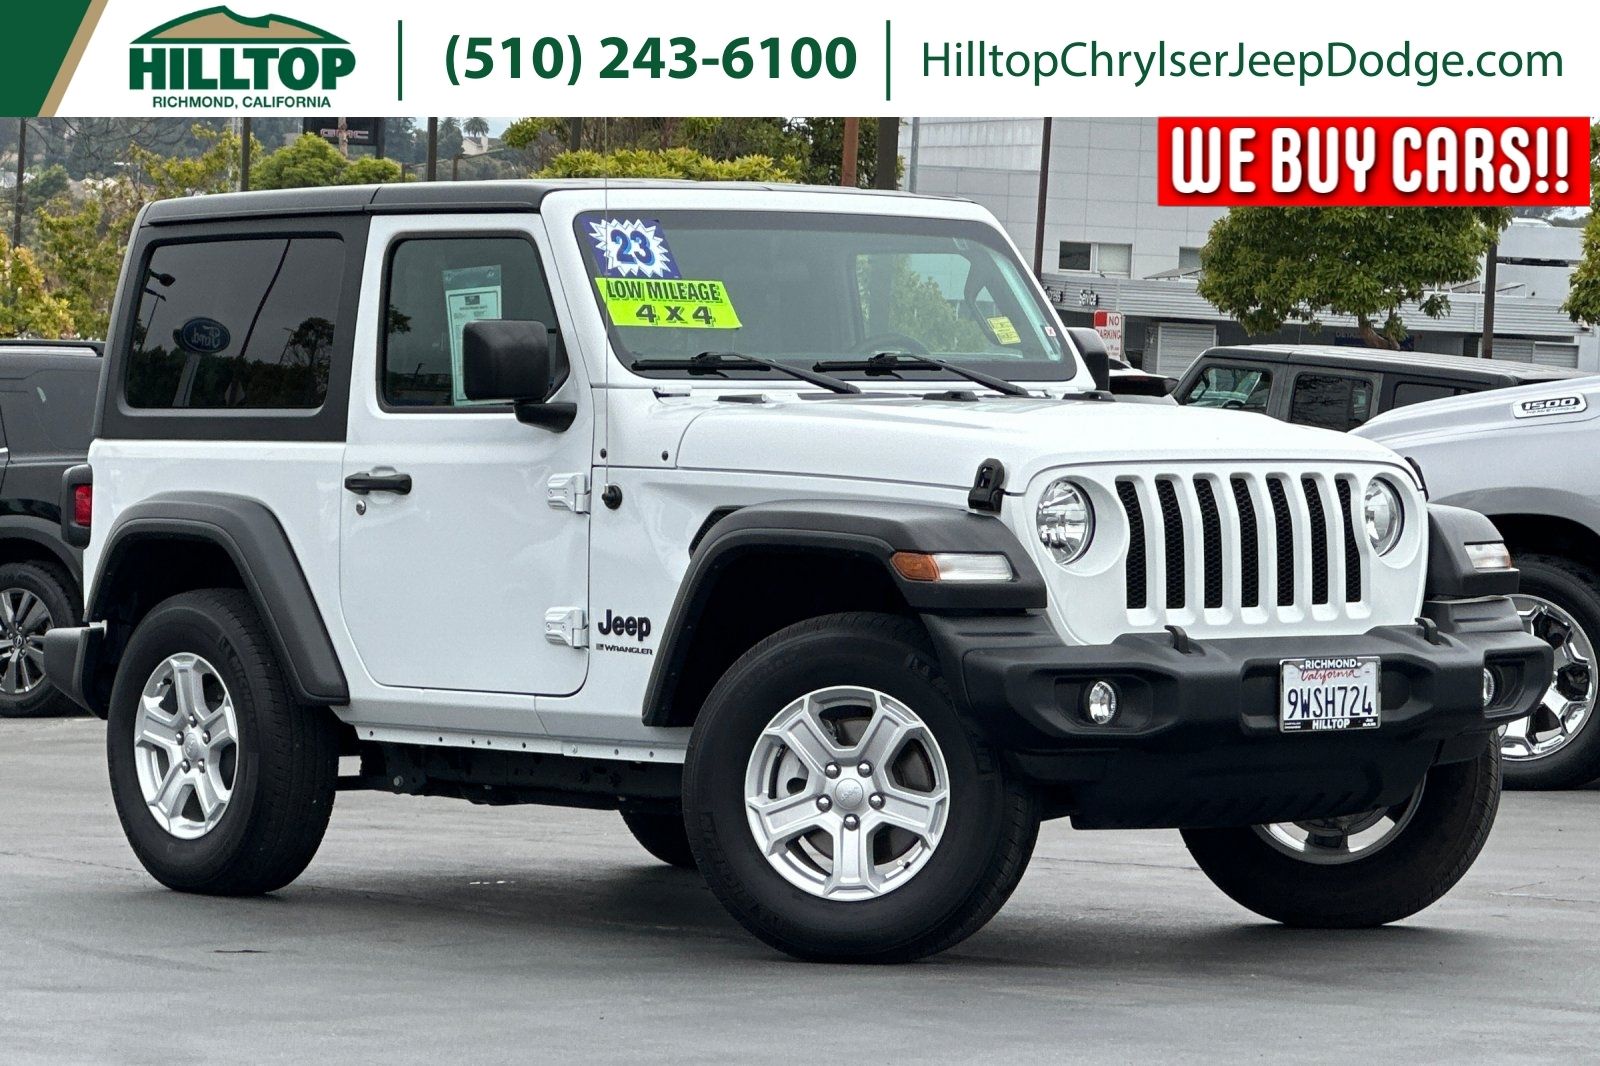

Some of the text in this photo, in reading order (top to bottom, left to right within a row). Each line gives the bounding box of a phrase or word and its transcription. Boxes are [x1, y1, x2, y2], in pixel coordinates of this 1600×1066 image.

[610, 229, 655, 266] 23
[606, 280, 722, 303] LOW MILEAGE
[1108, 316, 1120, 326] NO
[1524, 397, 1577, 411] 1500
[597, 609, 651, 642] Jeep
[604, 644, 653, 656] WRANGLER
[1305, 658, 1357, 669] RICHMOND
[1301, 669, 1360, 685] California
[1287, 685, 1373, 719] 9WSH724
[1312, 719, 1350, 730] HILLTOP
